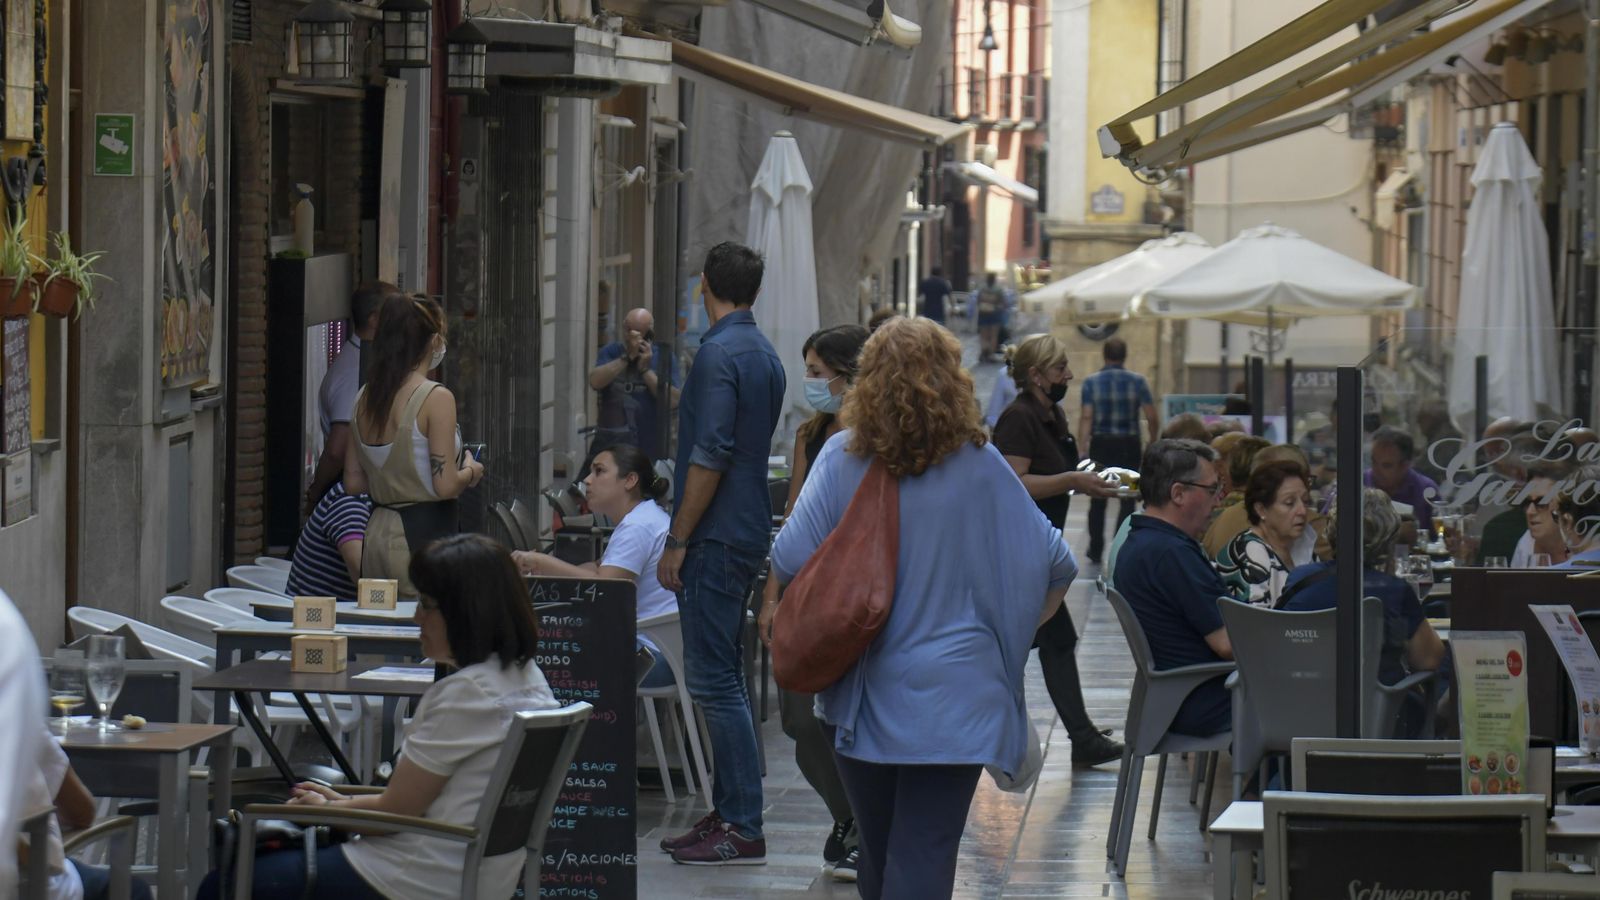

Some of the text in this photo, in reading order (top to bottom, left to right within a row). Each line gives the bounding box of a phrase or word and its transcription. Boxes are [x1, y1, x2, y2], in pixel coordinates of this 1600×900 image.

[1520, 418, 1600, 462] La
[542, 615, 584, 627] FRITOS
[1284, 629, 1319, 638] AMSTEL
[582, 762, 618, 772] SAUCE
[565, 777, 607, 789] SALSA
